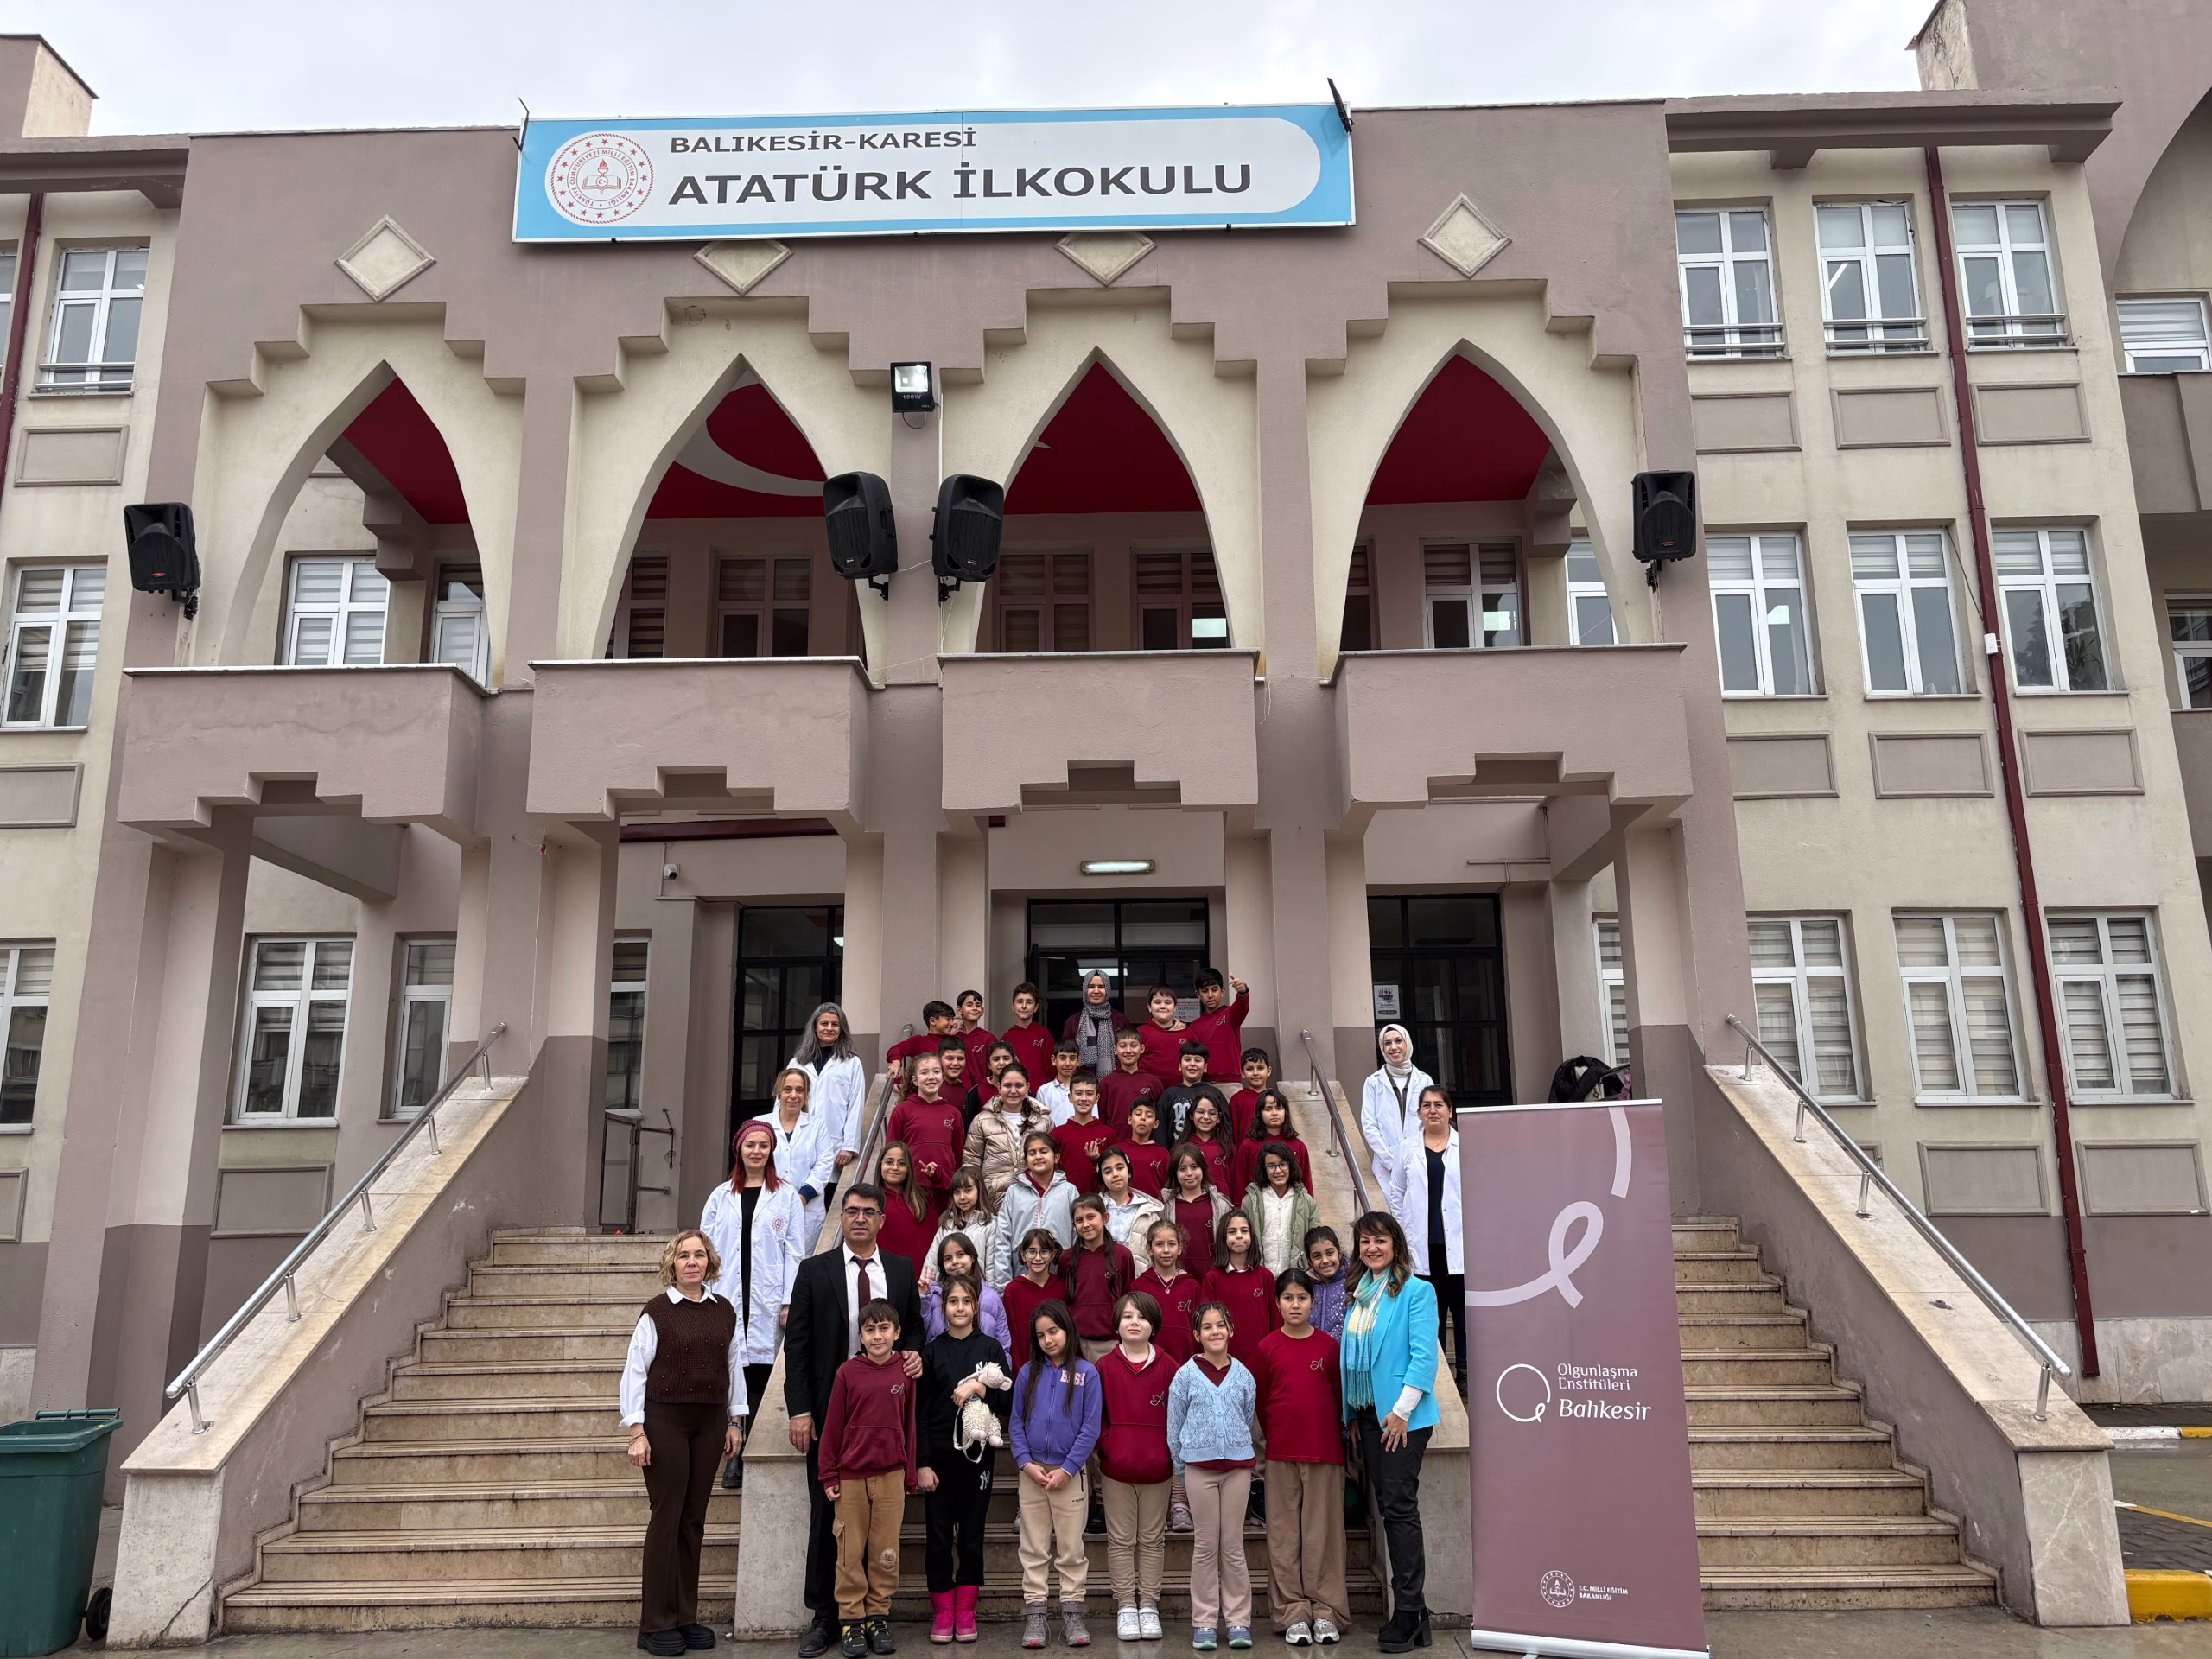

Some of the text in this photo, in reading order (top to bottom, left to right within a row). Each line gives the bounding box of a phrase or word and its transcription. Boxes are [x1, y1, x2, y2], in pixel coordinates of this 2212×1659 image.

[671, 127, 976, 154] BALIKESİR-KARESİ
[569, 149, 601, 185] CUMHURİYETİ
[601, 149, 621, 158] MİLLİ
[668, 162, 1251, 206] ATATÜRK İLKOKULU
[1557, 1363, 1638, 1380] Olgunlaşma
[1558, 1377, 1630, 1391] Enstitüleri
[1559, 1398, 1652, 1421] Balıkesir
[1579, 1592, 1612, 1601] BAKANLIĞI
[1606, 1586, 1629, 1595] EĞİTİM
